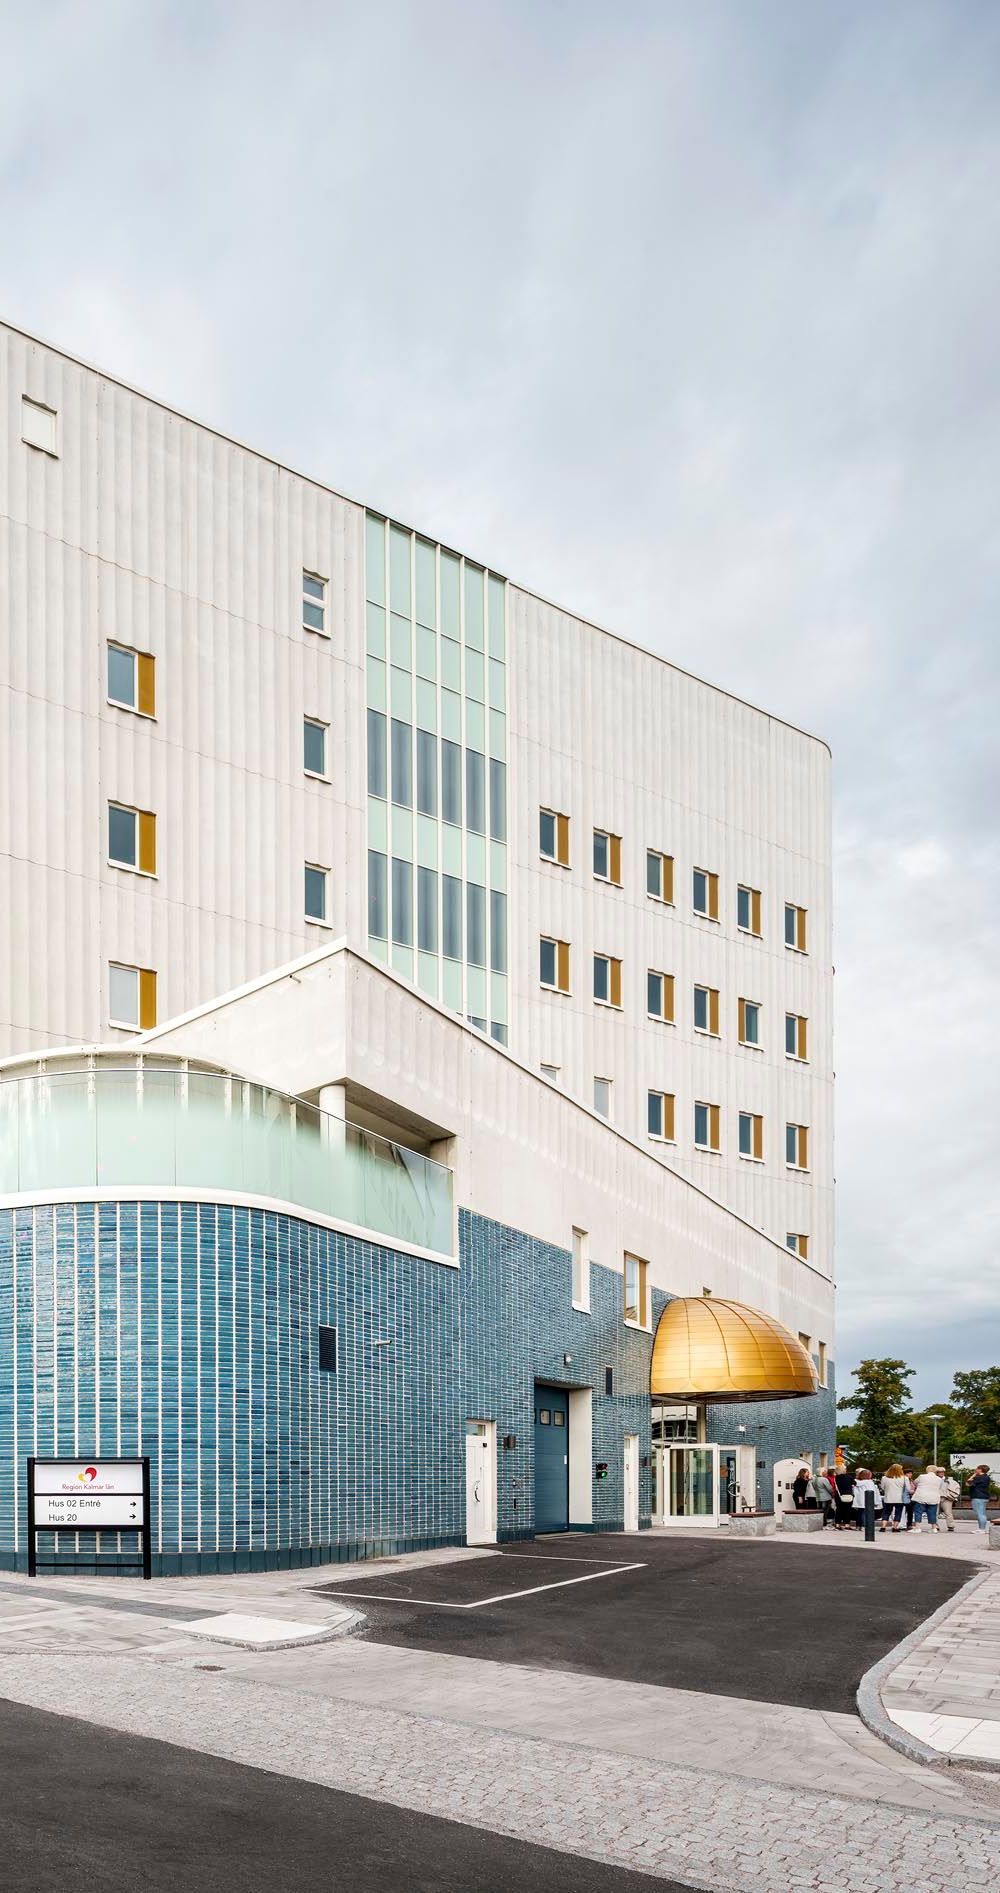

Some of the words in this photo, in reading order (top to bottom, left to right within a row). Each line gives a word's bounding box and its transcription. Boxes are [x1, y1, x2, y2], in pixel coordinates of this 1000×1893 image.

[48, 1499, 65, 1507] Hus
[66, 1499, 77, 1507] 02
[79, 1499, 101, 1507] Entré
[48, 1513, 65, 1521] Hus
[66, 1513, 77, 1521] 20
